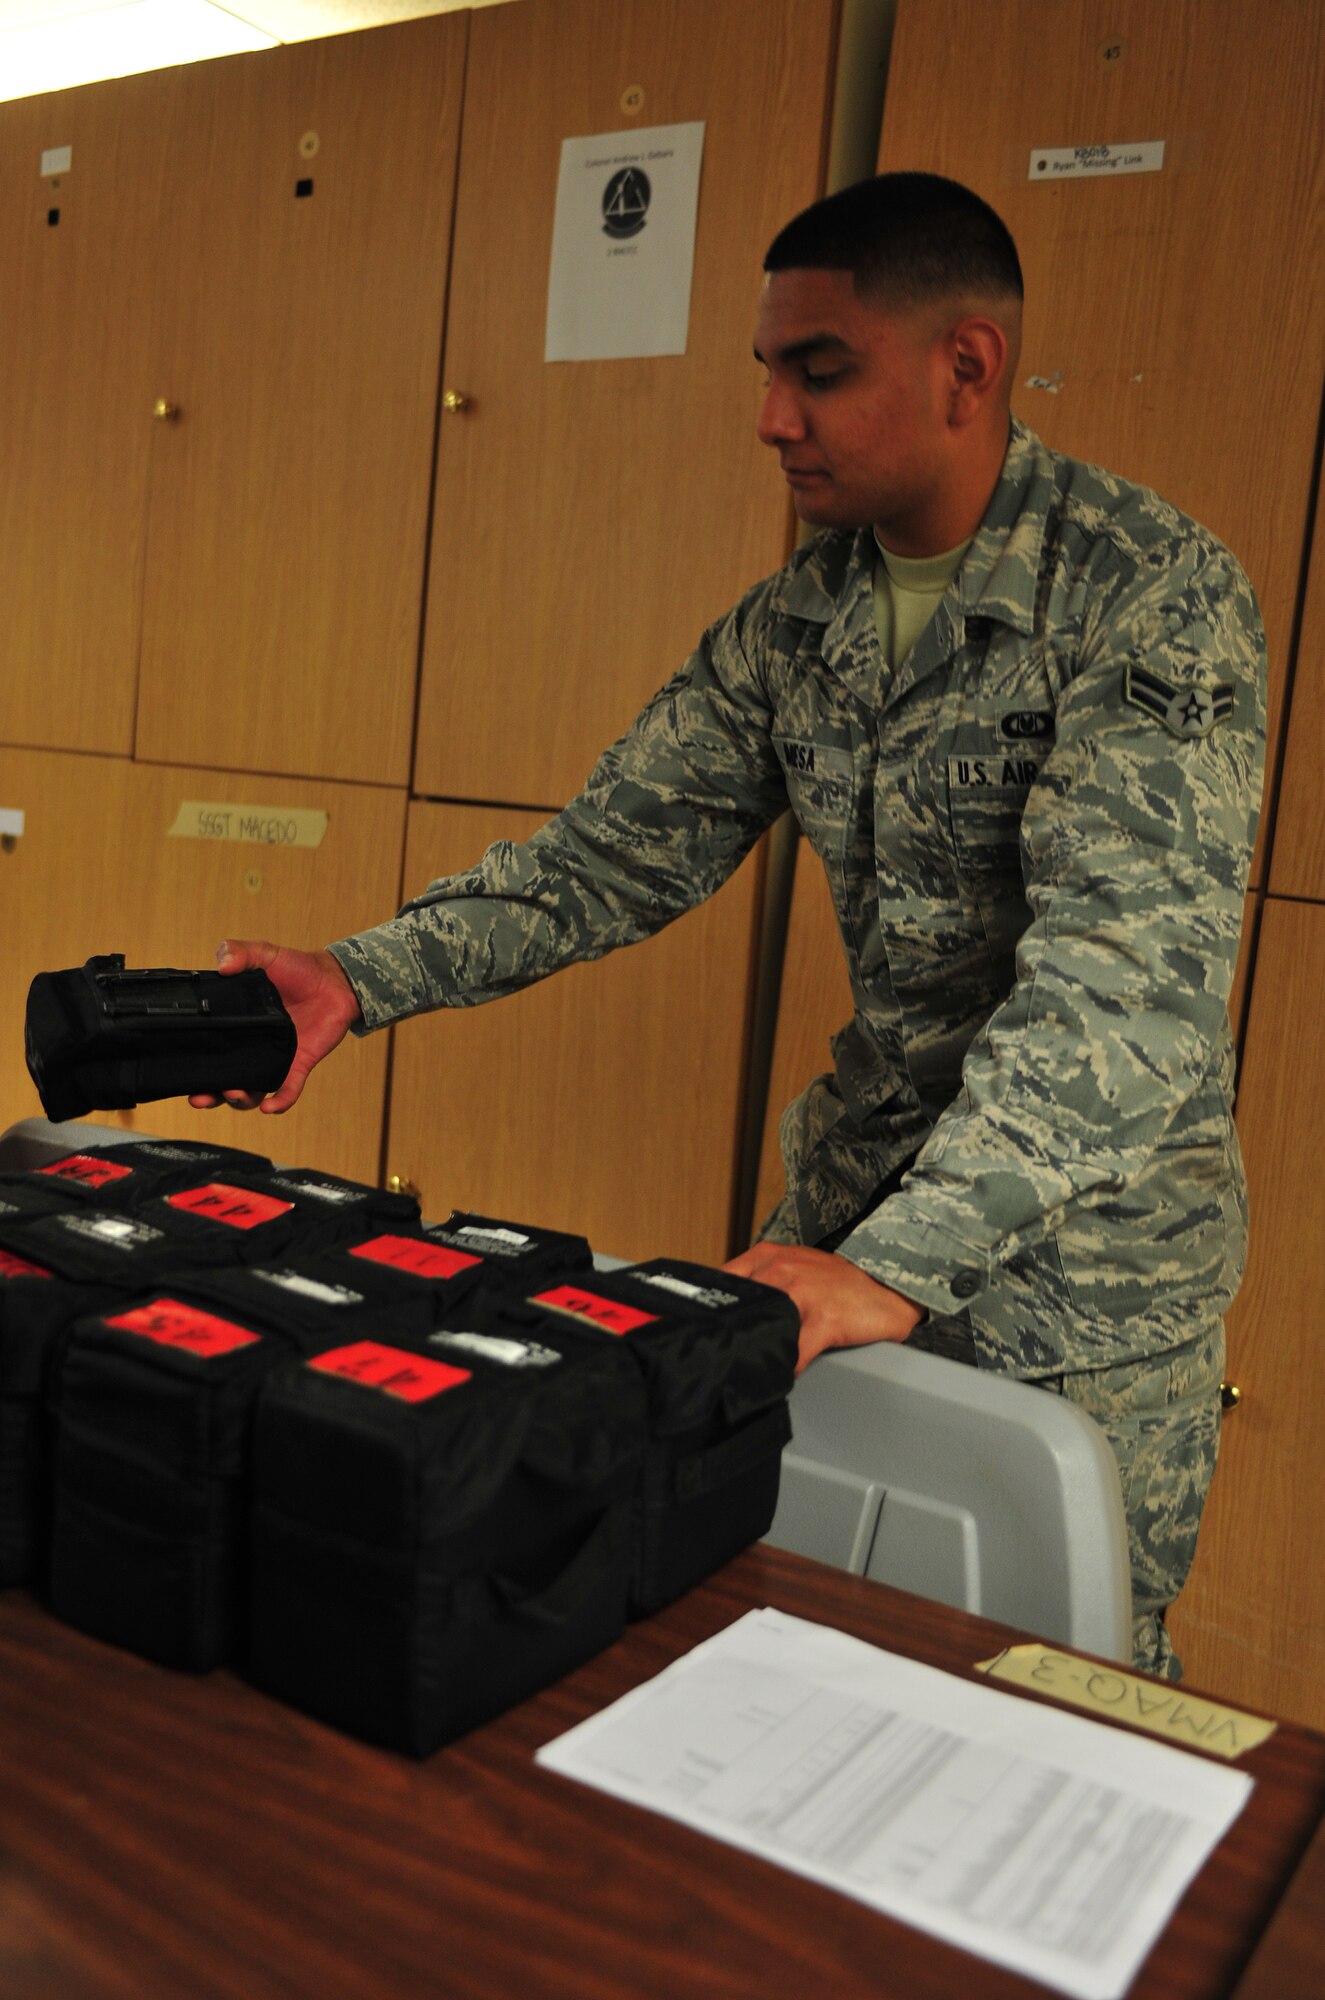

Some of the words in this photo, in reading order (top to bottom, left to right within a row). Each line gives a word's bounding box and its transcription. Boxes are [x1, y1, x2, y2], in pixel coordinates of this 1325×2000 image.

[1103, 45, 1121, 61] 45
[1052, 161, 1076, 173] Ryan
[1123, 153, 1143, 165] Link
[783, 741, 815, 772] MESA
[957, 760, 993, 786] U.S.
[197, 810, 232, 838] SSGT
[238, 816, 298, 845] MACEDO
[1030, 1654, 1241, 1750] VMAQ-3
